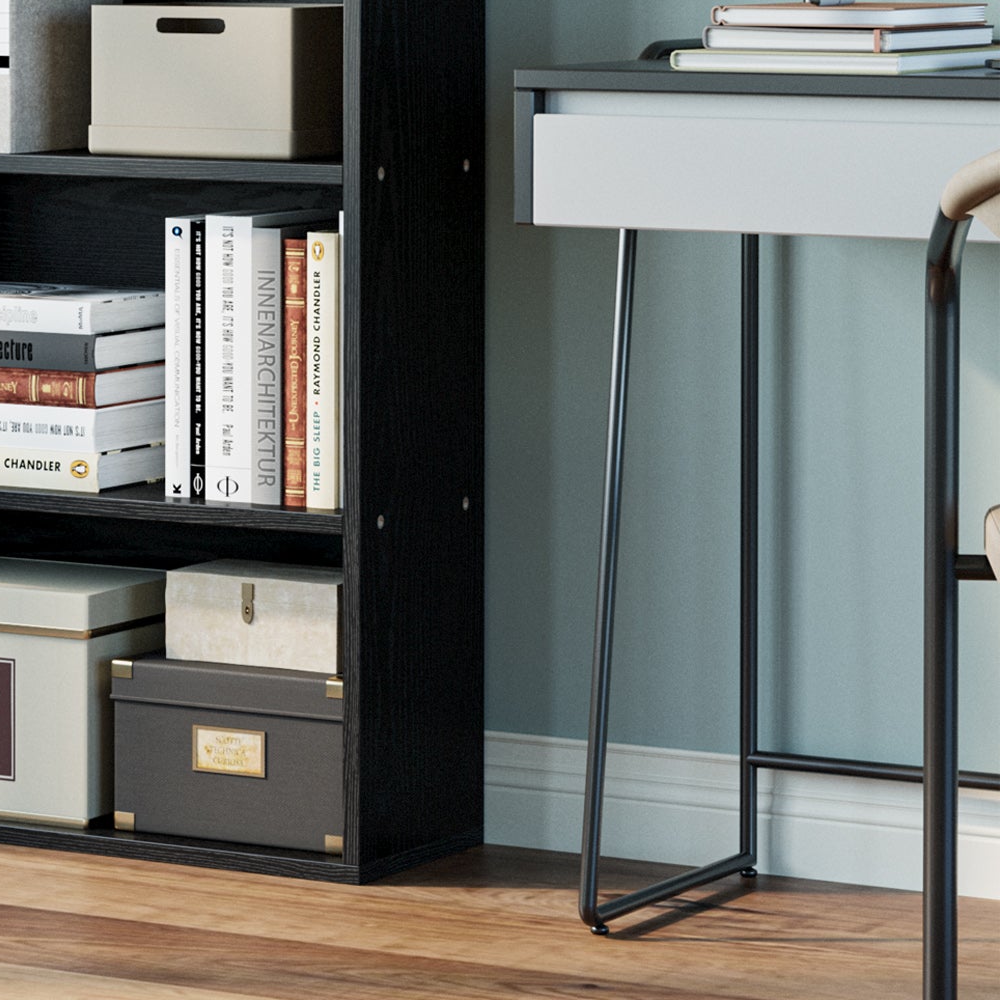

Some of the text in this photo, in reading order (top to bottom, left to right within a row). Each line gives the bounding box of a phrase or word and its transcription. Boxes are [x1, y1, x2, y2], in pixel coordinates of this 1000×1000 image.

[223, 240, 234, 252] NOT
[223, 287, 234, 298] YOU
[289, 319, 302, 360] JOURNEY
[312, 271, 321, 396] RAYMOND CHANDLER
[223, 376, 234, 392] WANT
[257, 270, 276, 486] INNENARCHITEKTUR
[289, 361, 299, 422] UNEXPECTED
[23, 422, 32, 433] YOU
[64, 425, 73, 436] NOT
[223, 424, 234, 437] Paul
[312, 412, 321, 492] THE BIG SLEEP
[4, 458, 61, 472] CHANDLER
